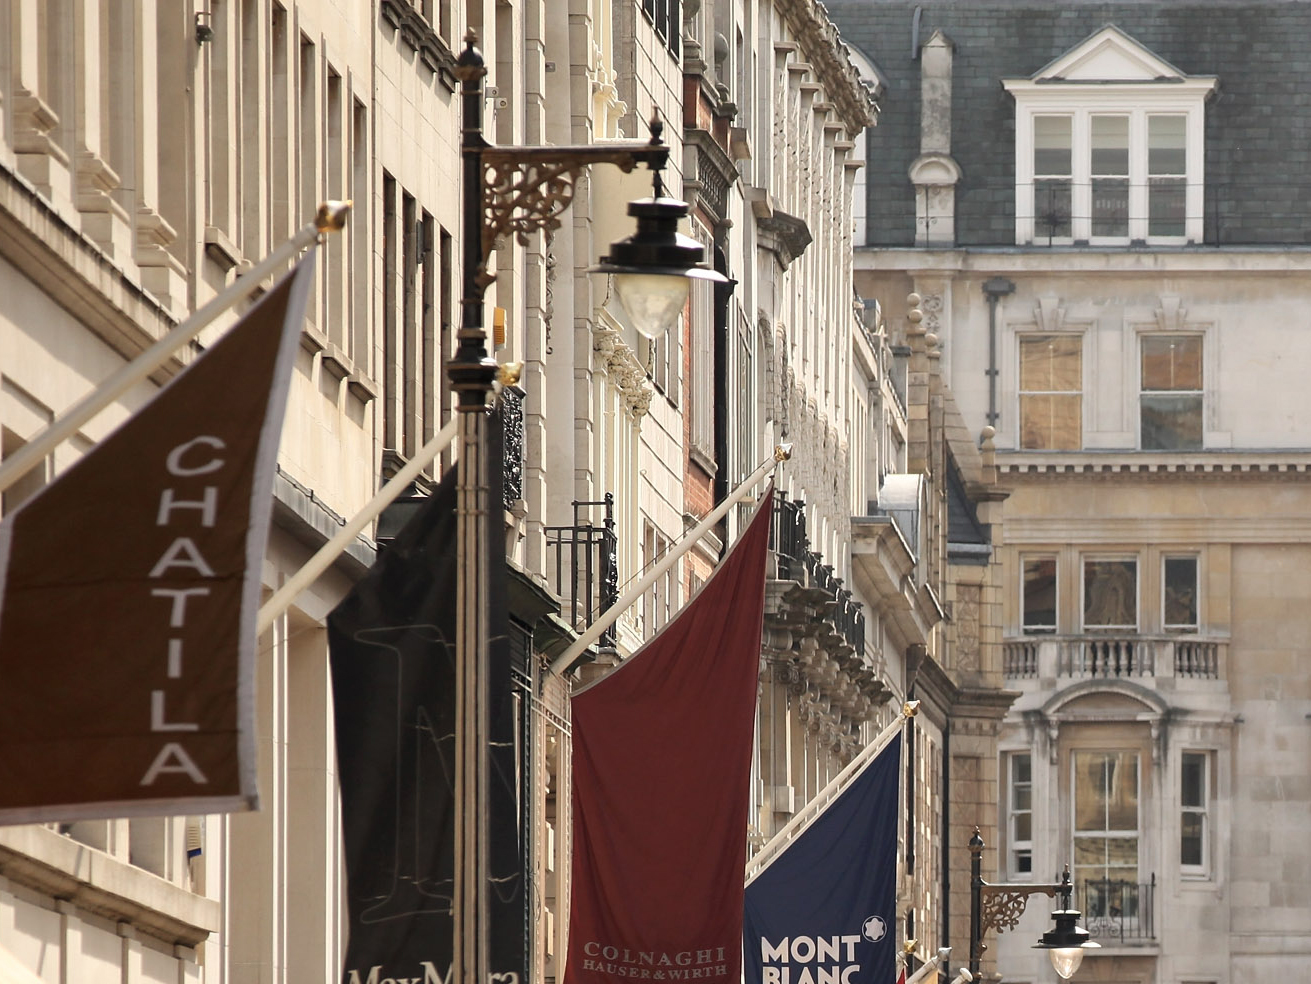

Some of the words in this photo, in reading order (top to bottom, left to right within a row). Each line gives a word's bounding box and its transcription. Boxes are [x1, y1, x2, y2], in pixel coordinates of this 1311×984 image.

[139, 436, 227, 786] CHATILA
[584, 941, 726, 966] COLNAGHI
[761, 935, 861, 963] MONT
